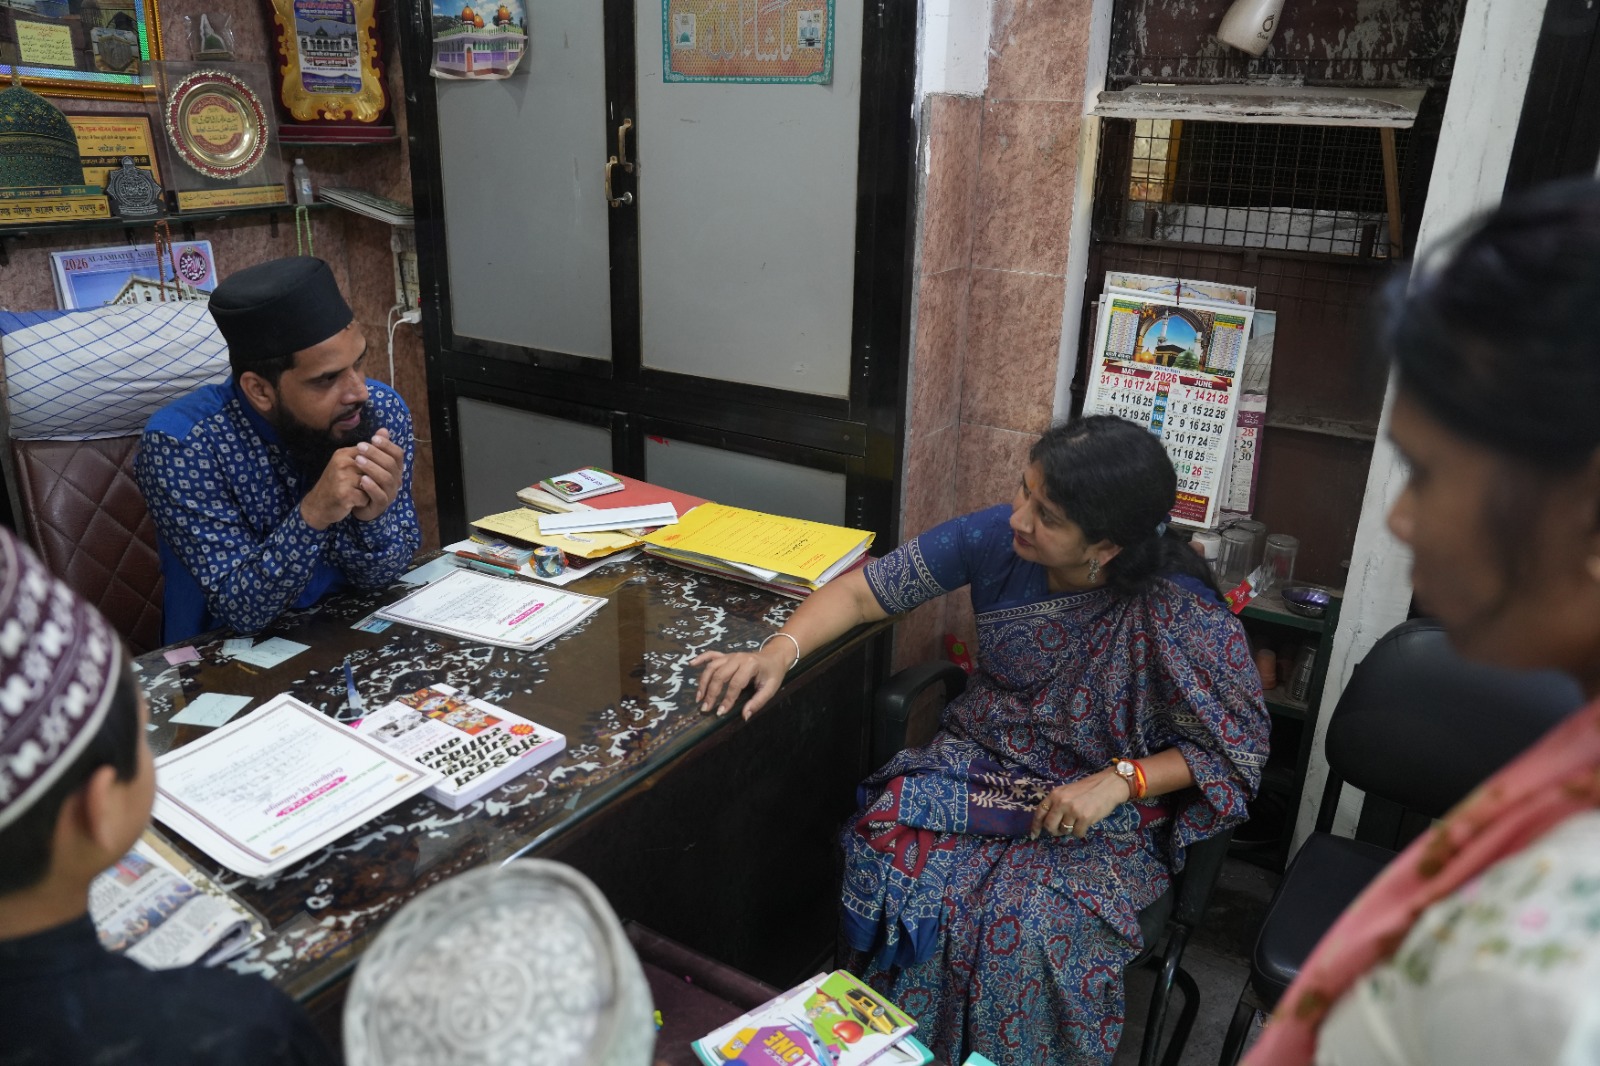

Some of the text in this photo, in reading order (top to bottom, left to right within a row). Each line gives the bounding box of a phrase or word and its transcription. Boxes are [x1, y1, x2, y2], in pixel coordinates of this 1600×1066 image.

[64, 257, 89, 271] 2026
[1121, 367, 1136, 376] MAY
[1154, 371, 1178, 383] 2026
[1100, 375, 1156, 392] 31 3 10 17 24
[1194, 380, 1213, 389] JUNE
[1111, 392, 1153, 407] 4 11 18 25
[1185, 389, 1229, 404] 7 14 21 28
[1109, 407, 1150, 421] 5 12 19 26
[1171, 402, 1226, 419] 1 8 15 22 29
[1168, 416, 1223, 434] 2 9 16 23 30
[1242, 427, 1254, 436] 28
[1165, 431, 1170, 440] 3
[1175, 433, 1185, 443] 10
[1187, 435, 1197, 445] 17
[1198, 437, 1208, 447] 24
[1240, 440, 1253, 449] 29
[1172, 447, 1205, 461] 11 18 25
[1239, 452, 1252, 461] 30
[1181, 465, 1190, 474] 19
[1191, 465, 1202, 476] 26
[1178, 479, 1199, 490] 20 27
[763, 1030, 805, 1063] ONE
